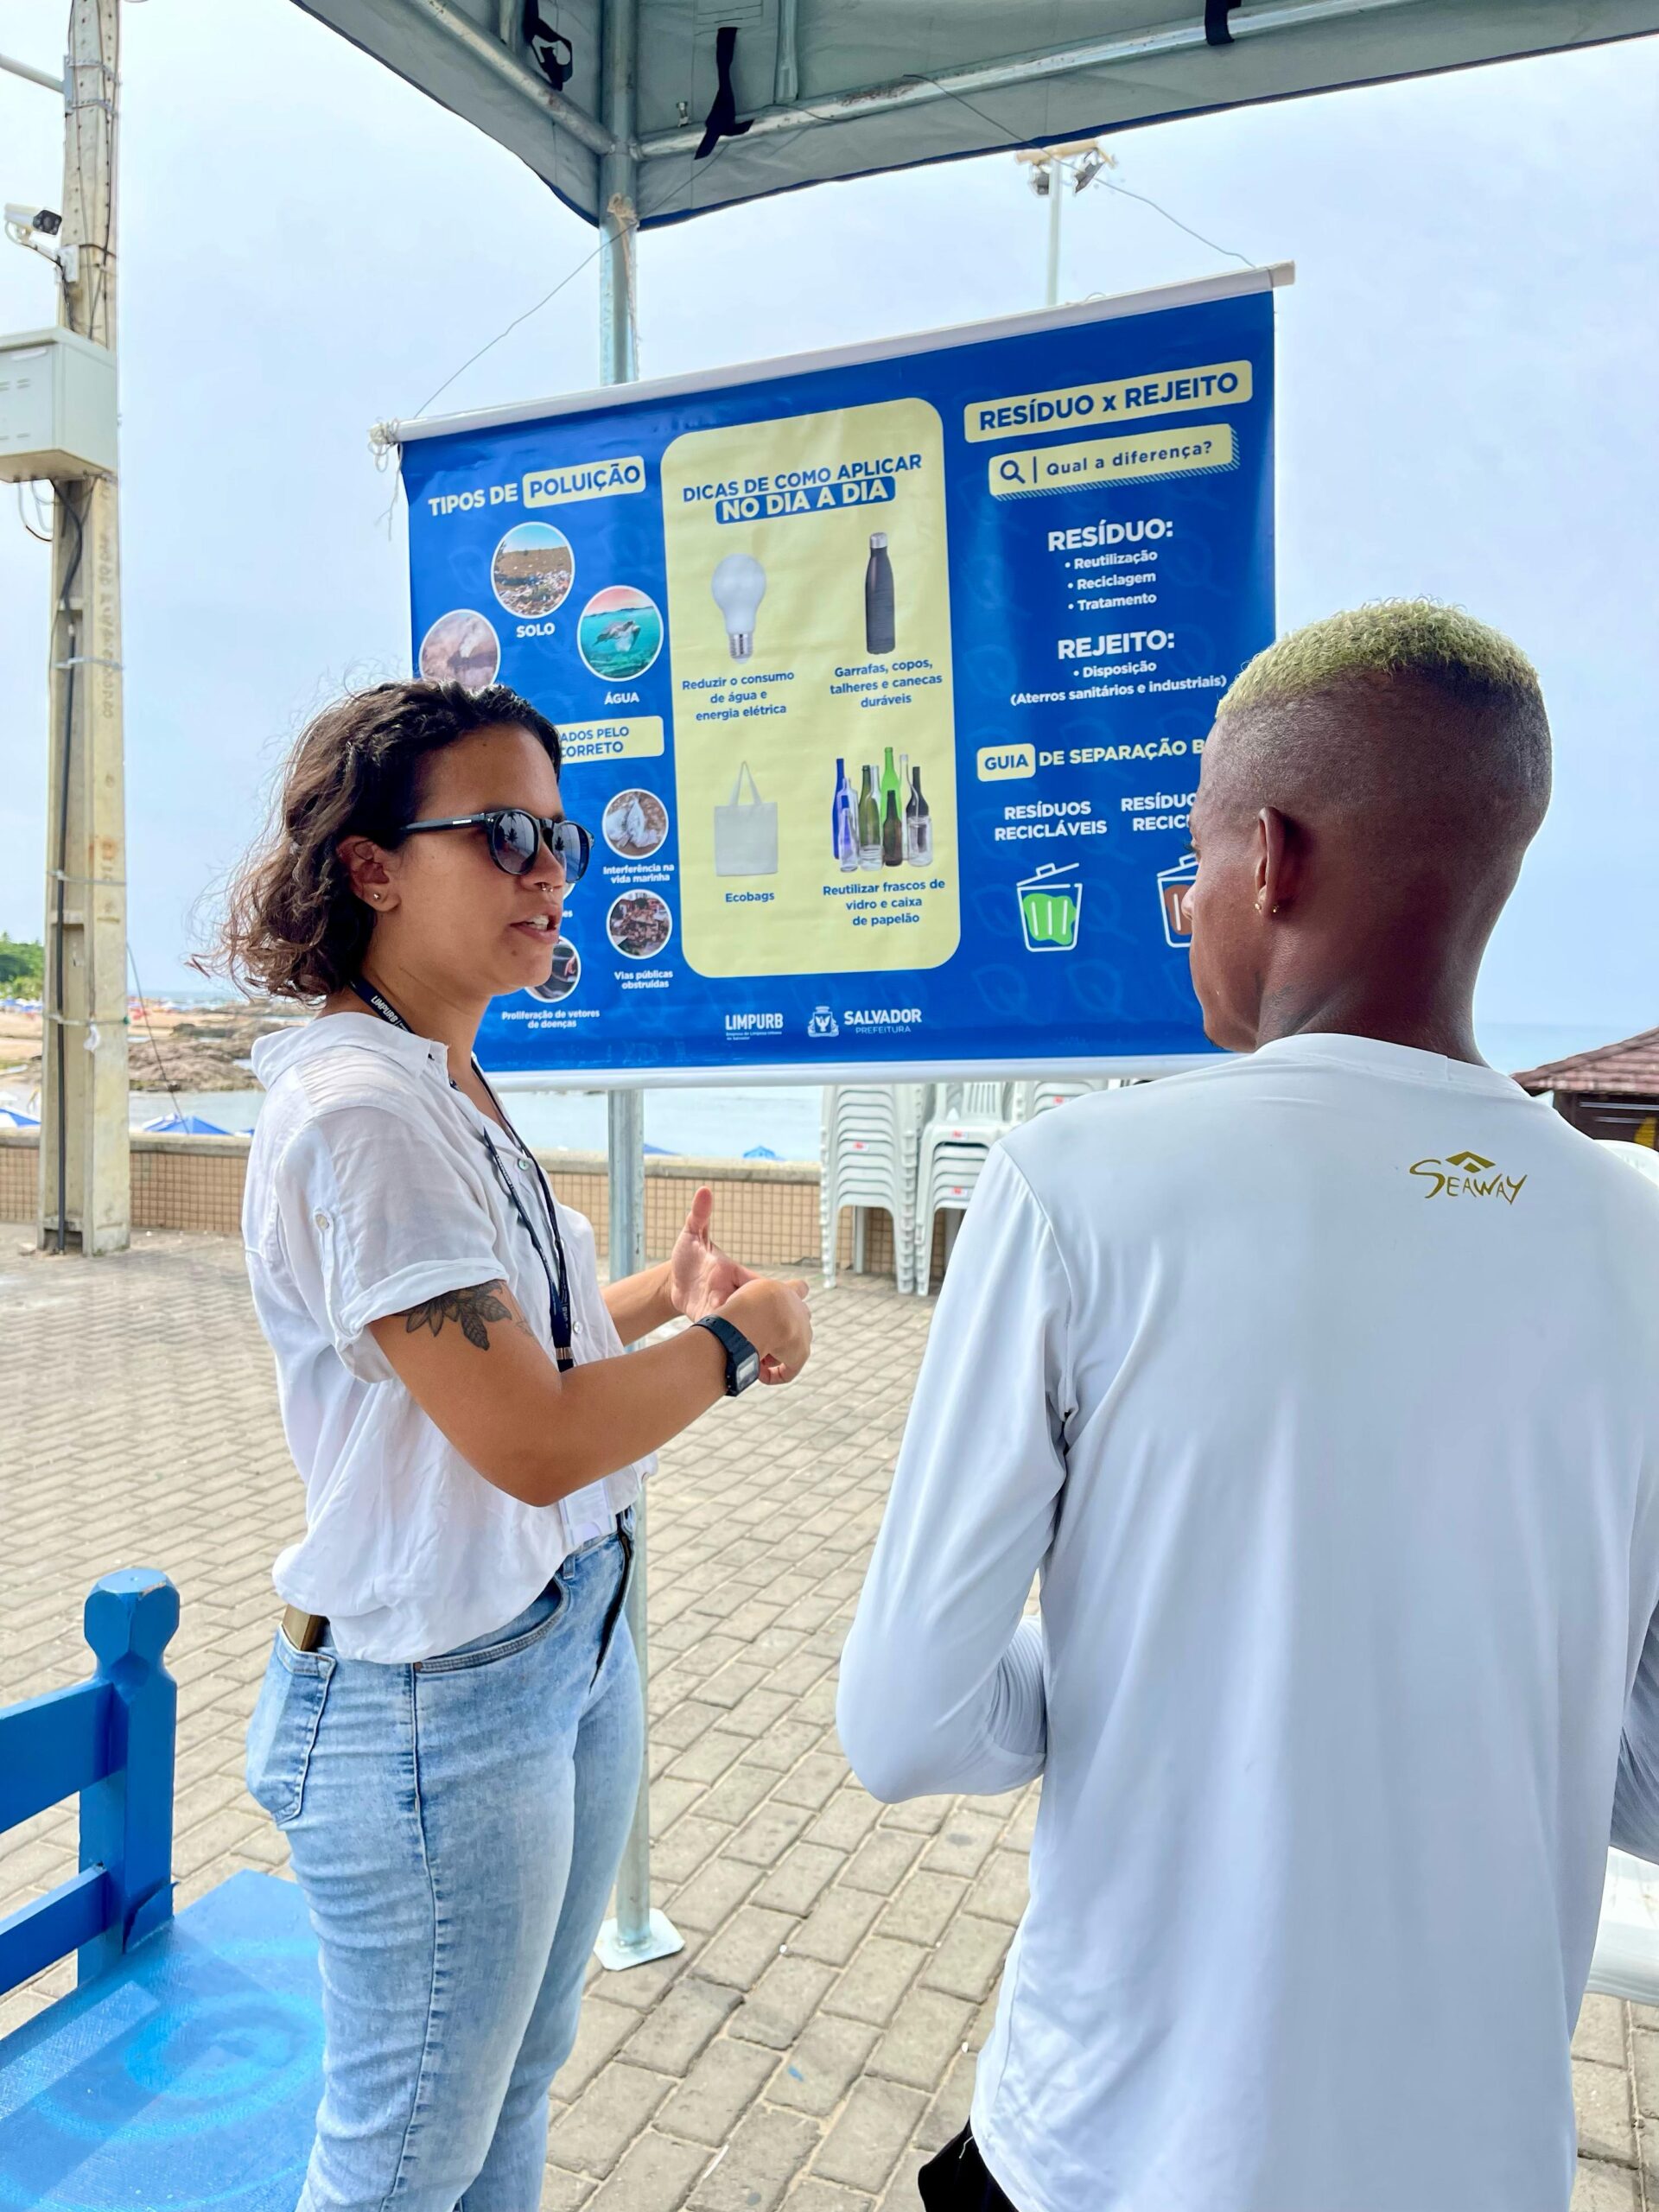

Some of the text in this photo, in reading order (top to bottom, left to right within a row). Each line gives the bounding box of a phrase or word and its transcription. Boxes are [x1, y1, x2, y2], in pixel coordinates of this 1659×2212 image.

[980, 394, 1094, 430] RESÍDUO
[1125, 372, 1238, 409] REJEITO
[1046, 441, 1213, 476] Qual a diferença?
[683, 454, 922, 502] DICAS DE COMO APLICAR
[429, 463, 640, 517] TIPOS DE POLUIÇÃO
[721, 480, 888, 521] NO DIA A DIA
[1048, 518, 1173, 551] RESÍDUO:
[1074, 550, 1158, 569] Reutilização
[1077, 572, 1156, 591] Reciclagem
[1077, 592, 1157, 611] Tratamento
[516, 622, 556, 638] SOLO
[1058, 629, 1175, 659] REJEITO:
[835, 658, 933, 677] Garrafas, copos,
[1083, 660, 1157, 678] Disposição
[682, 677, 727, 690] Reduzir
[741, 671, 794, 683] consumo
[830, 674, 943, 695] talheres e canecas
[1010, 674, 1226, 706] (Aterros sanitários e industriais)
[604, 691, 639, 705] ÁGUA
[710, 693, 725, 704] de
[728, 691, 757, 705] água
[861, 693, 912, 709] duráveis
[696, 702, 787, 722] energia elétrica
[597, 726, 629, 739] PELO
[983, 753, 1029, 771] GUIA
[1039, 750, 1065, 766] DE
[1070, 737, 1187, 765] SEPARAÇÃO
[1004, 800, 1091, 820] RESÍDUOS
[995, 819, 1108, 842] RECICLÁVEIS
[603, 864, 661, 874] Interferência
[611, 874, 671, 884] vida marinha
[823, 878, 945, 896] Reutilizar frascos de
[725, 890, 775, 905] Ecobags
[845, 896, 923, 912] vidro e caixa
[852, 912, 920, 928] de papelão
[614, 969, 673, 981] Vias públicas
[621, 980, 669, 989] obstruídas
[502, 1009, 601, 1021] Proliferação de vetores
[541, 1020, 577, 1029] doenças
[725, 1013, 784, 1031] LIMPURB
[843, 1007, 922, 1026] SALVADOR
[855, 1026, 912, 1035] PREFEITURA
